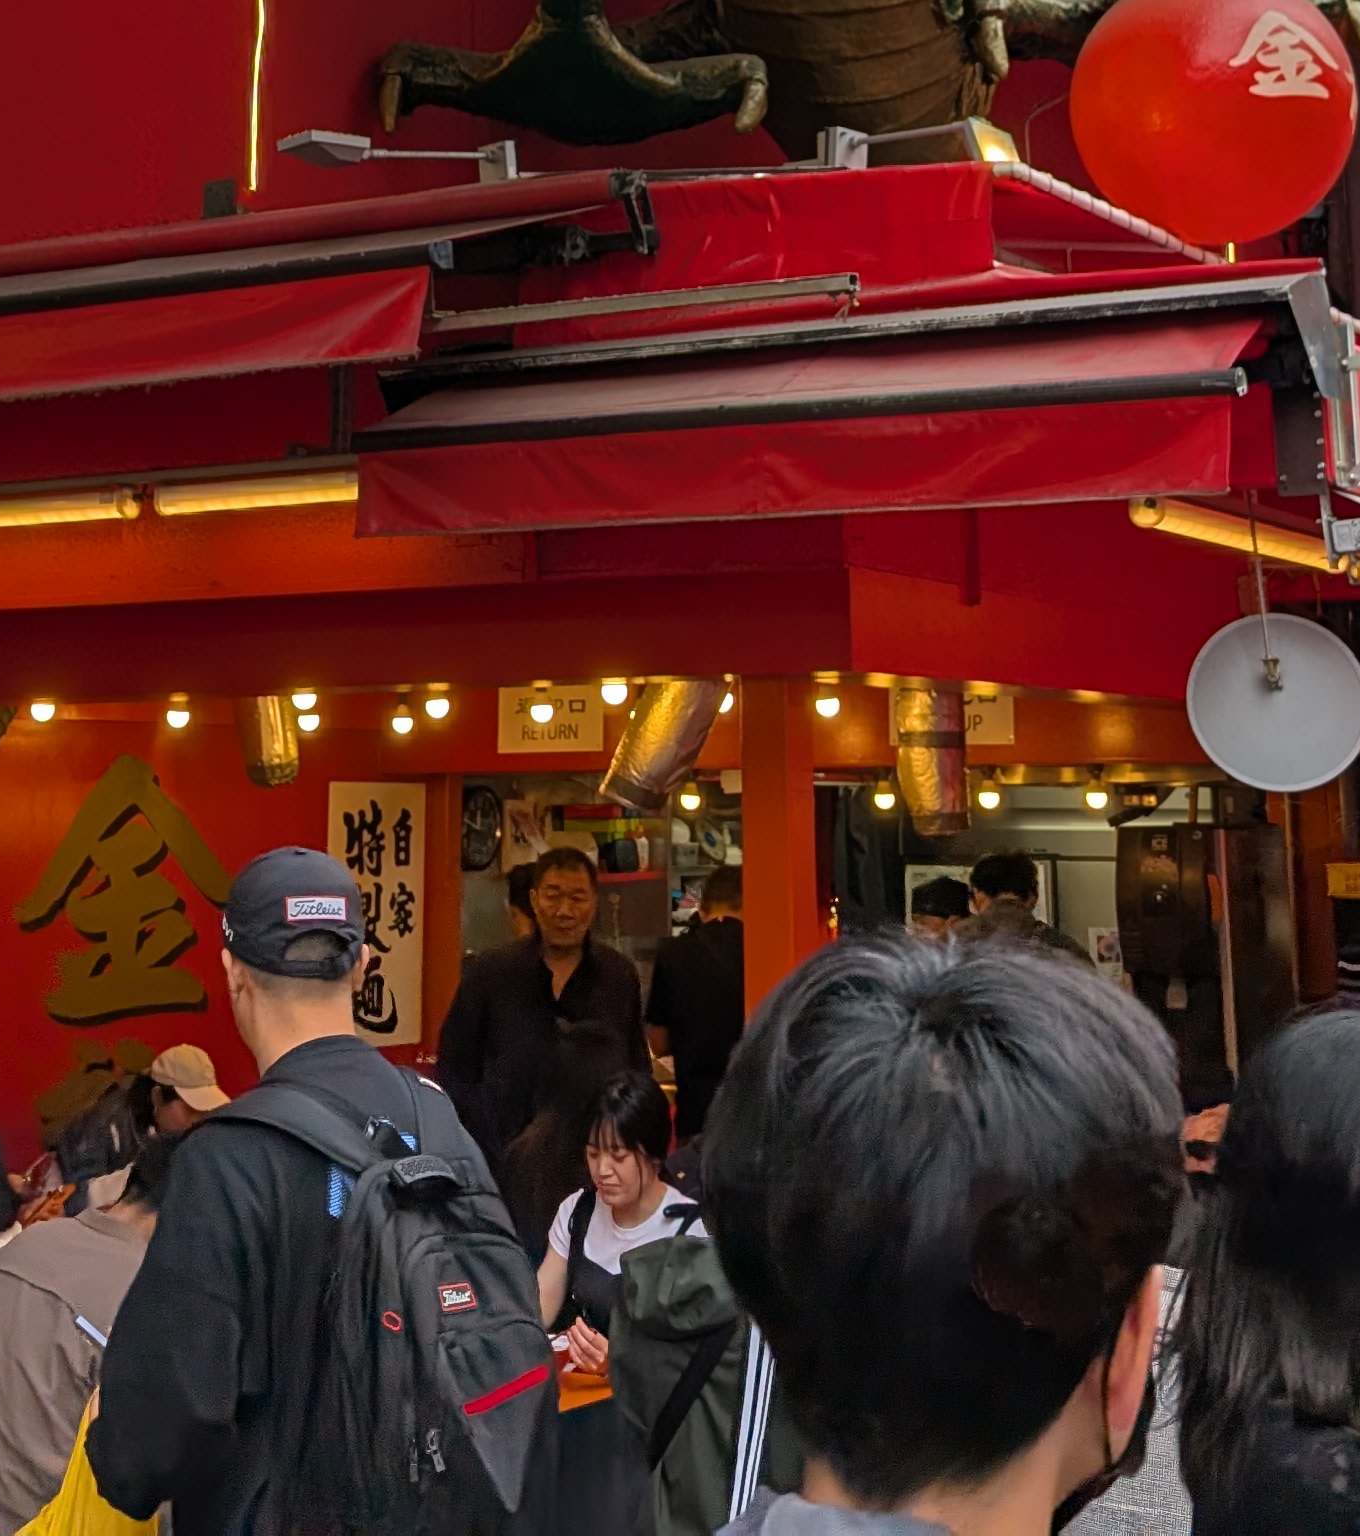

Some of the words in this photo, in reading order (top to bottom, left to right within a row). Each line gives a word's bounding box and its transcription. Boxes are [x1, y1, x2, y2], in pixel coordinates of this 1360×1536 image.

[515, 697, 586, 714] 返口
[289, 899, 344, 918] Titleist
[388, 808, 416, 938] 自家
[15, 754, 232, 1139] 金
